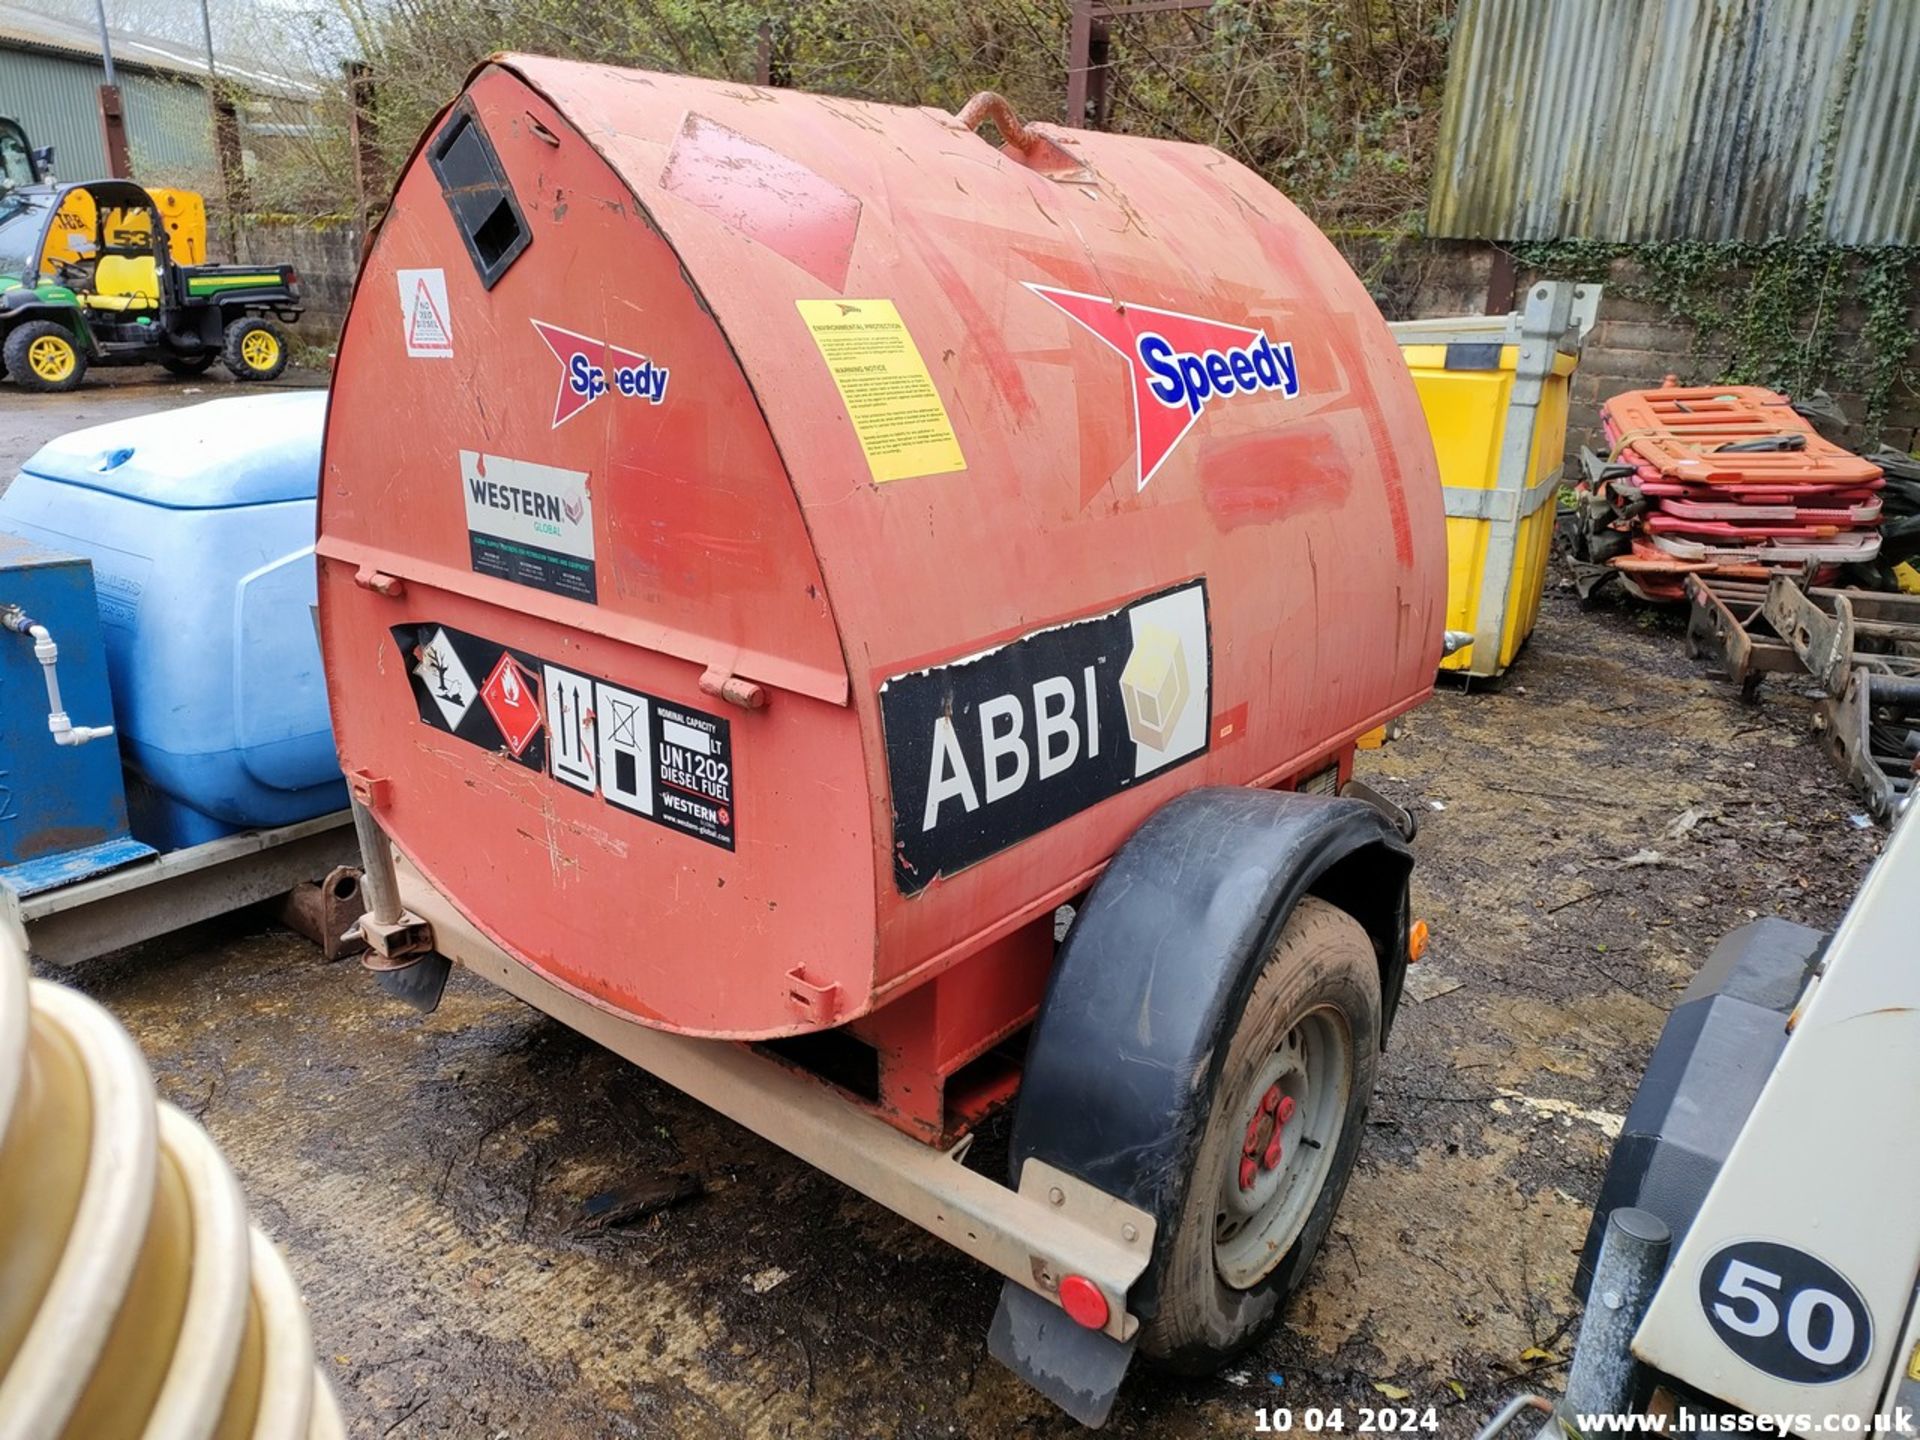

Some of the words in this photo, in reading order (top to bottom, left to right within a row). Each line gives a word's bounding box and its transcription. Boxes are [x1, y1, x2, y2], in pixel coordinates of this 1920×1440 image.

[1139, 334, 1299, 415] Speedy
[469, 478, 561, 522] WESTERN
[533, 521, 562, 537] GLOBAL
[657, 706, 685, 724] NOMINAL
[685, 716, 716, 734] CAPACITY
[659, 742, 728, 786] UN1202
[710, 738, 722, 755] LT
[922, 665, 1099, 832] ABBI
[661, 764, 699, 791] DIESEL
[702, 780, 729, 802] FUEL
[662, 792, 718, 824] WESTERN
[1714, 1259, 1855, 1365] 50
